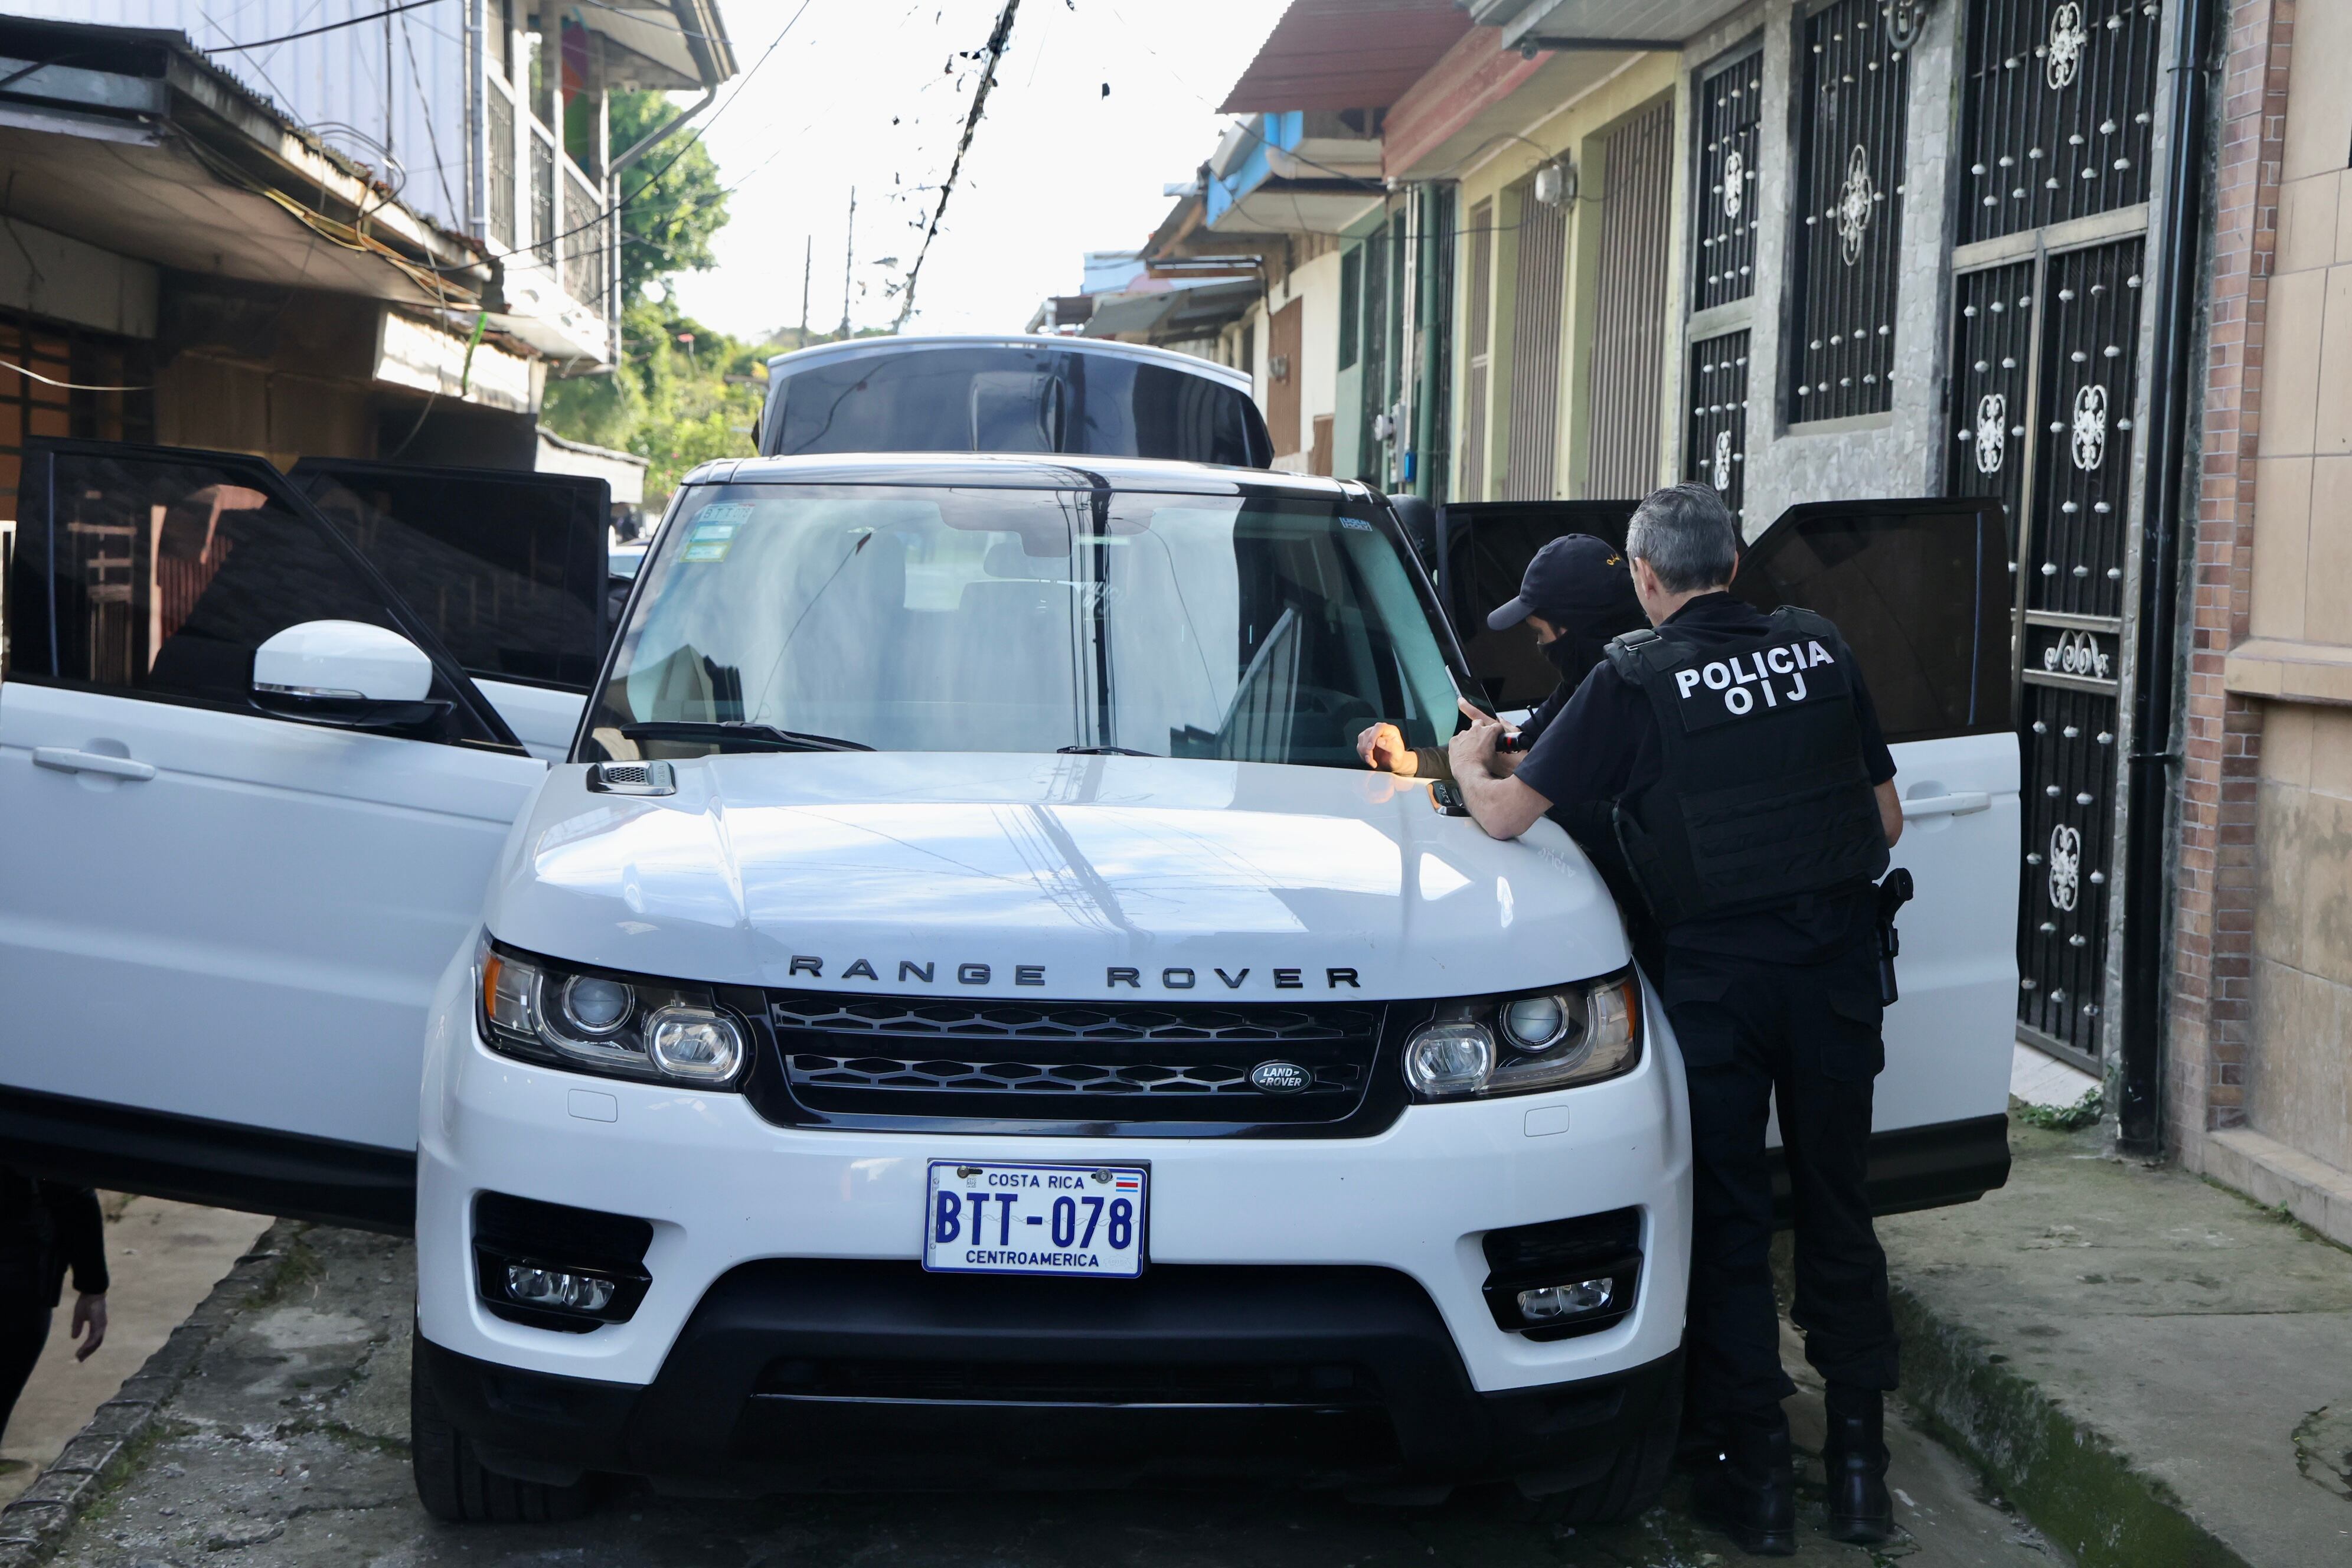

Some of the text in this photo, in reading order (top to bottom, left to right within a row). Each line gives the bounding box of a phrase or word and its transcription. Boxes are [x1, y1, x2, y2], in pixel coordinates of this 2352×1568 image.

[1675, 640, 1834, 699] POLICIA
[789, 955, 1361, 989] RANGE ROVER
[1263, 1067, 1293, 1077] LAND
[1265, 1077, 1302, 1086] ROVER
[988, 1173, 1084, 1190] COSTA RICA
[935, 1190, 1133, 1250] BTT-078
[966, 1250, 1099, 1268] CENTROAMERICA
